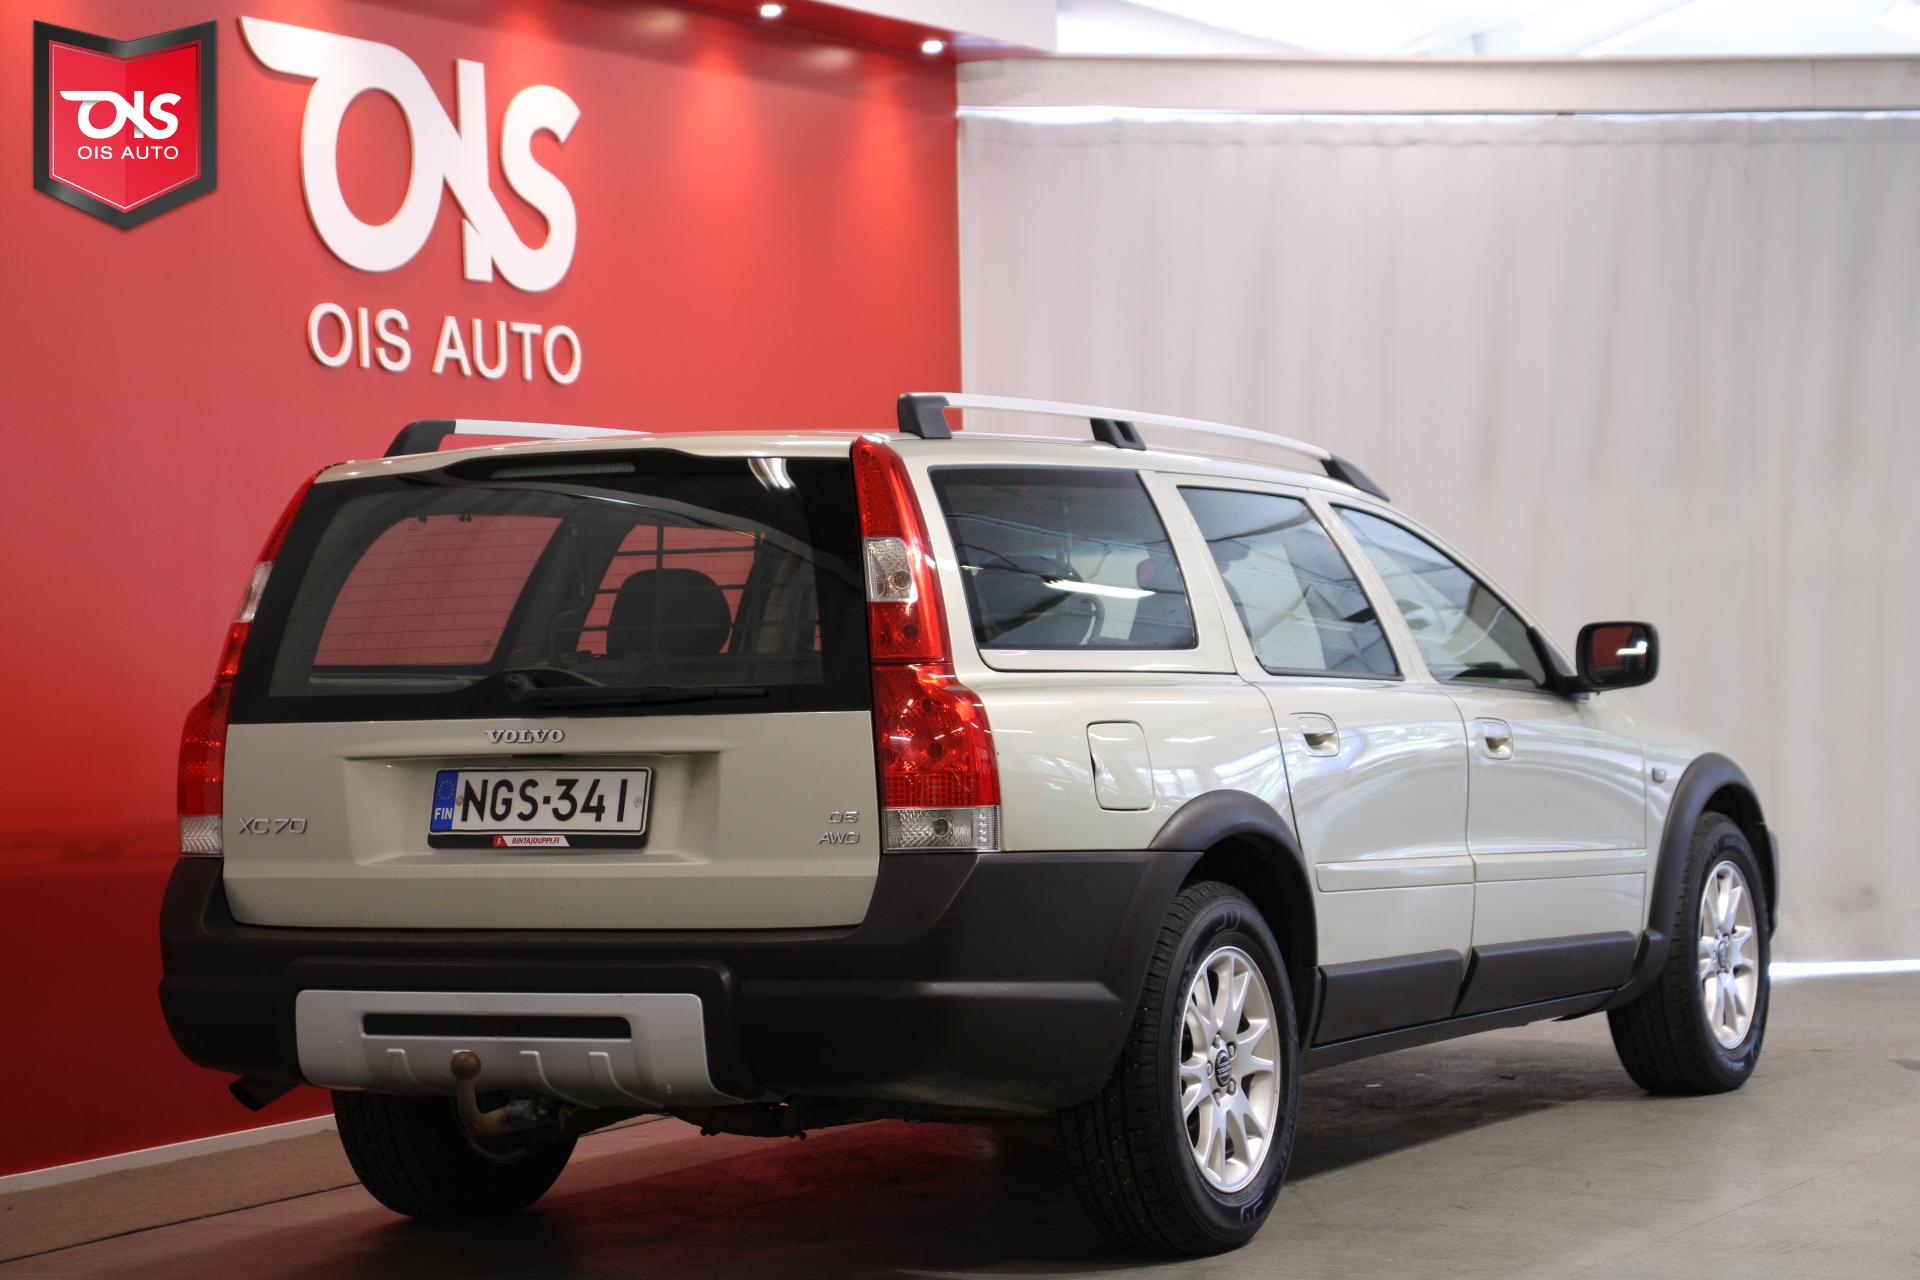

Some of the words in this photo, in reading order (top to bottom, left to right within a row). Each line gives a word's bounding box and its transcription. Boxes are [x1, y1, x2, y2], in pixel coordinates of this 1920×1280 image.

[308, 302, 412, 373] OIS
[432, 315, 582, 386] AUTO
[485, 729, 564, 744] VOLVO
[434, 807, 453, 820] FIN
[511, 836, 560, 845] RINTAJOUPPI.FI
[817, 831, 860, 845] AWD
